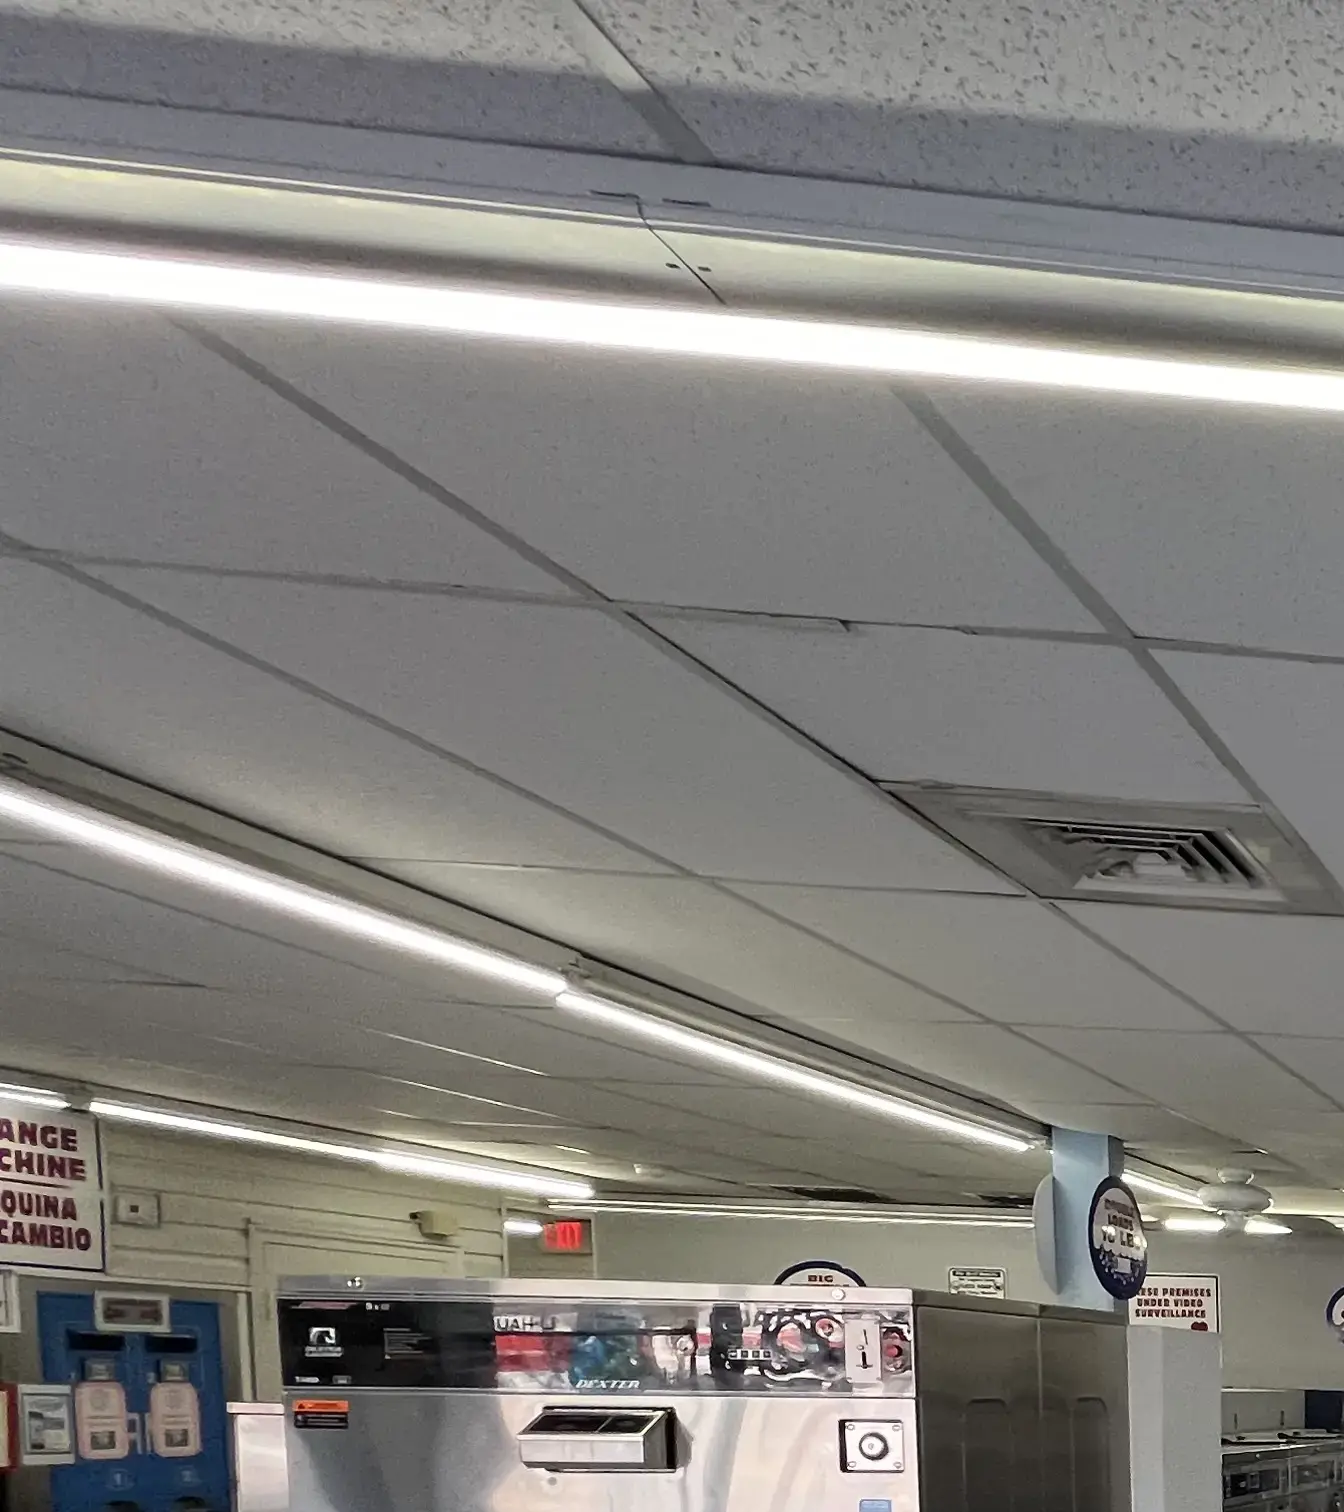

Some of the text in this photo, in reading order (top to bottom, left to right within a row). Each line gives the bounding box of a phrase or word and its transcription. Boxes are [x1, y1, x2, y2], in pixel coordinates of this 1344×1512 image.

[0, 1190, 77, 1220] QUINA
[0, 1219, 91, 1251] CAMBIO
[807, 1274, 833, 1283] BIG
[1163, 1288, 1211, 1297] PREMISES
[1137, 1299, 1203, 1308] UNDER VIDEO
[1135, 1309, 1206, 1318] SURVEILLANCE
[575, 1379, 641, 1389] DEXTER
